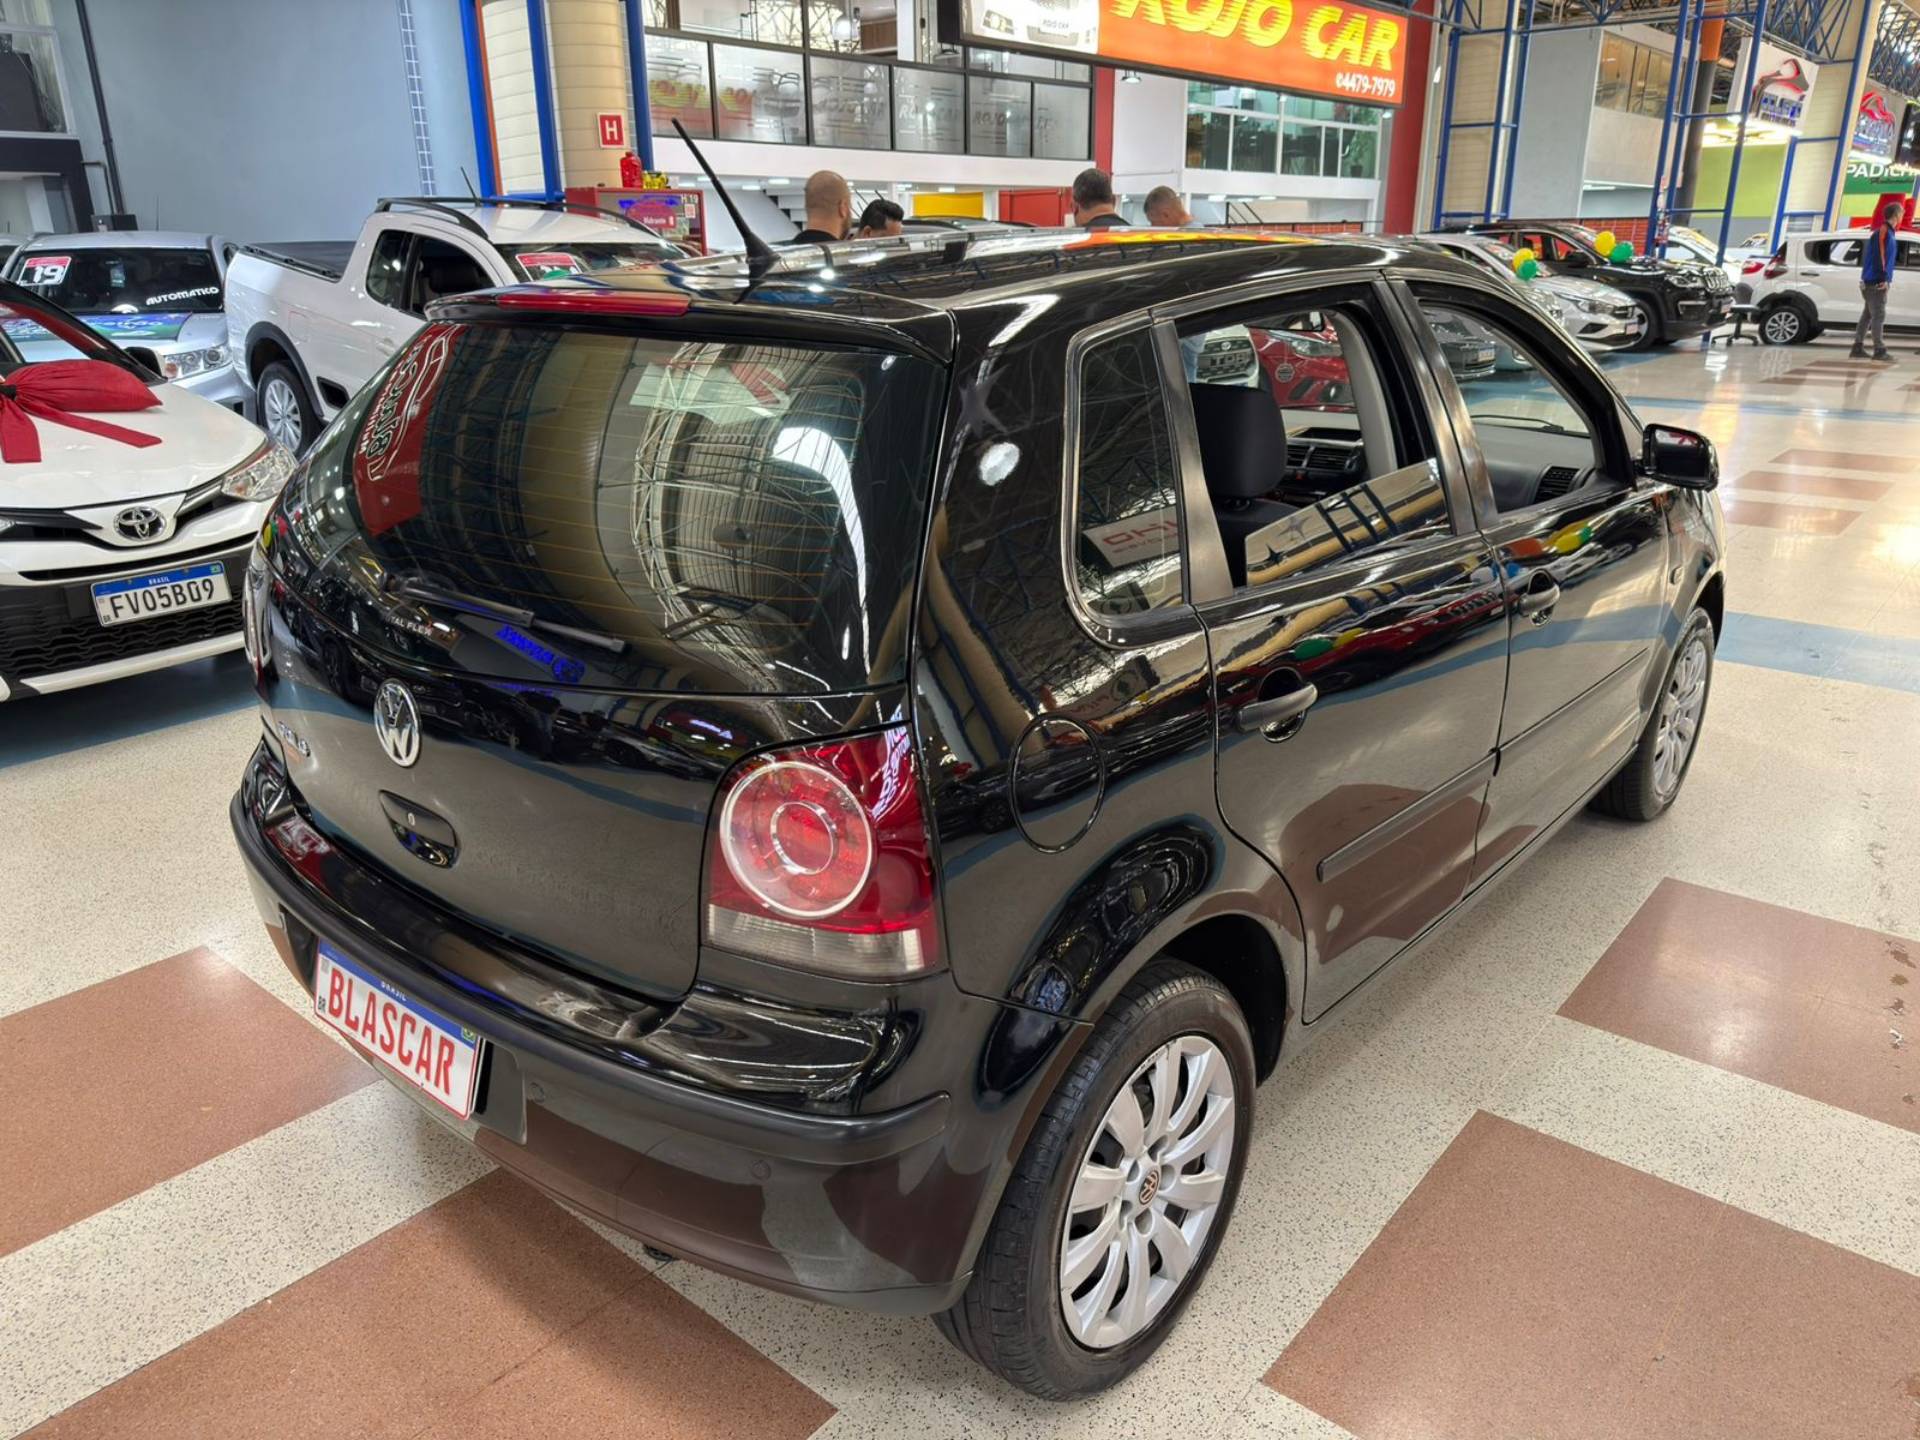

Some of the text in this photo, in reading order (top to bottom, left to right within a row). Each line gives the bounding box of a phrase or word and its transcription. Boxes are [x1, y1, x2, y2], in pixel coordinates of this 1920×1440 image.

[1301, 5, 1399, 71] CAR
[605, 119, 619, 141] H
[148, 576, 170, 585] BRASIL
[380, 980, 408, 1002] BRASIL
[328, 966, 456, 1096] BLASCAR
